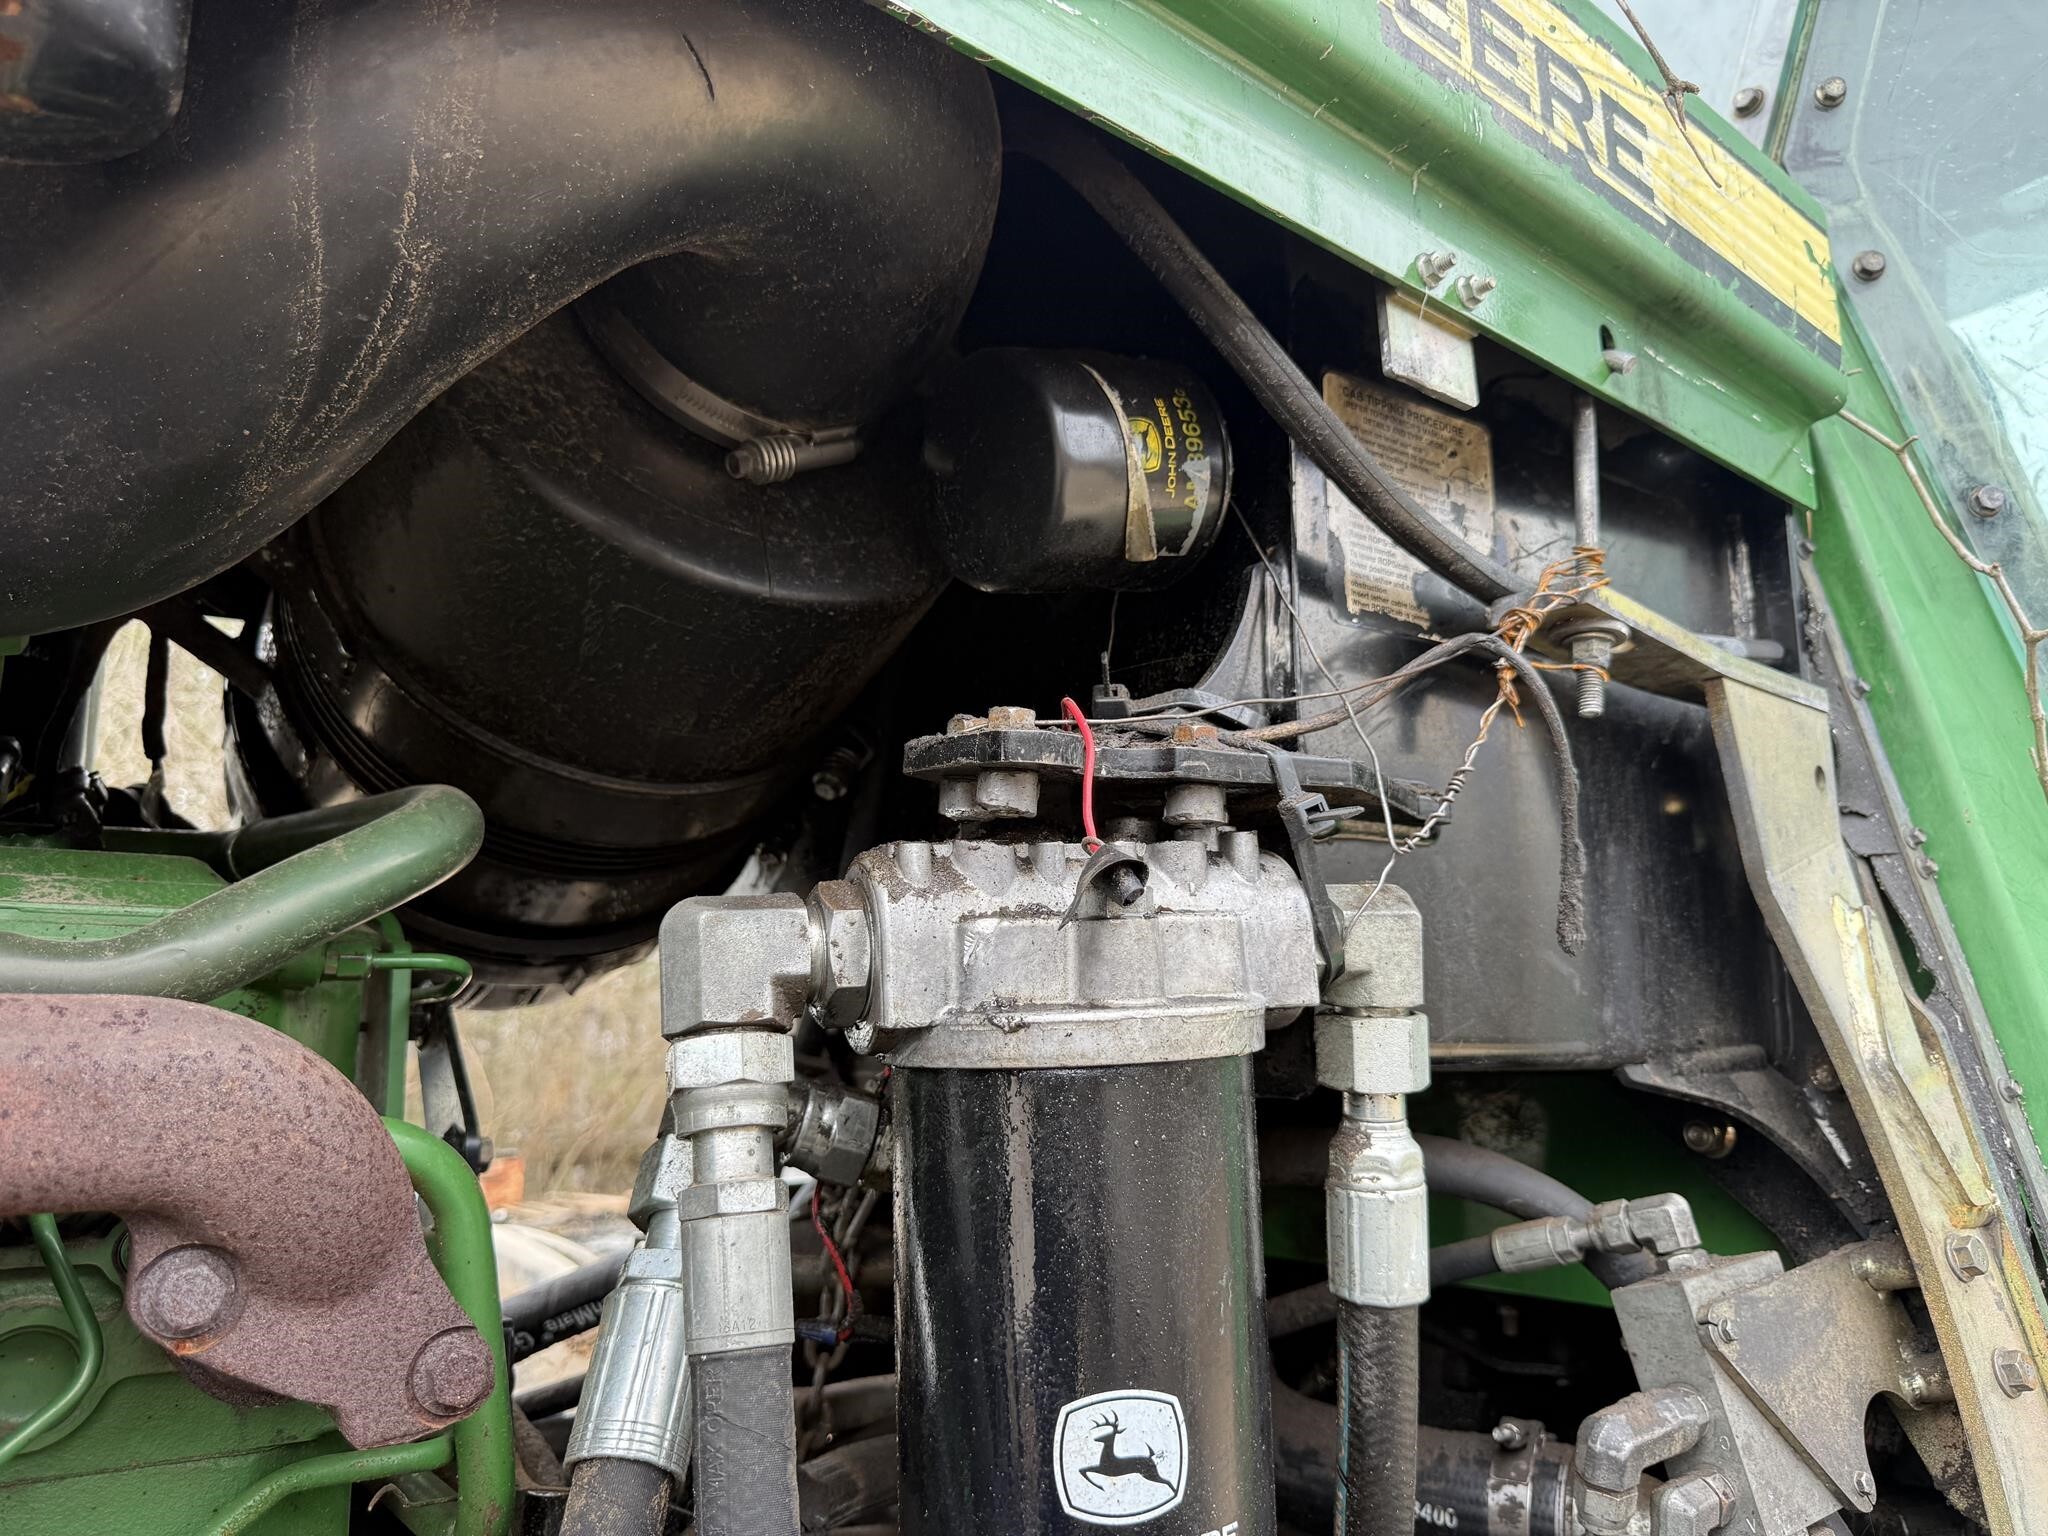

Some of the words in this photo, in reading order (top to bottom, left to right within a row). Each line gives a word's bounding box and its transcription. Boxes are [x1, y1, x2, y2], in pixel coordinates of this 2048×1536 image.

[1154, 397, 1176, 449] DEERE
[1406, 408, 1465, 439] PROCEDURE
[1165, 451, 1177, 499] JOHN
